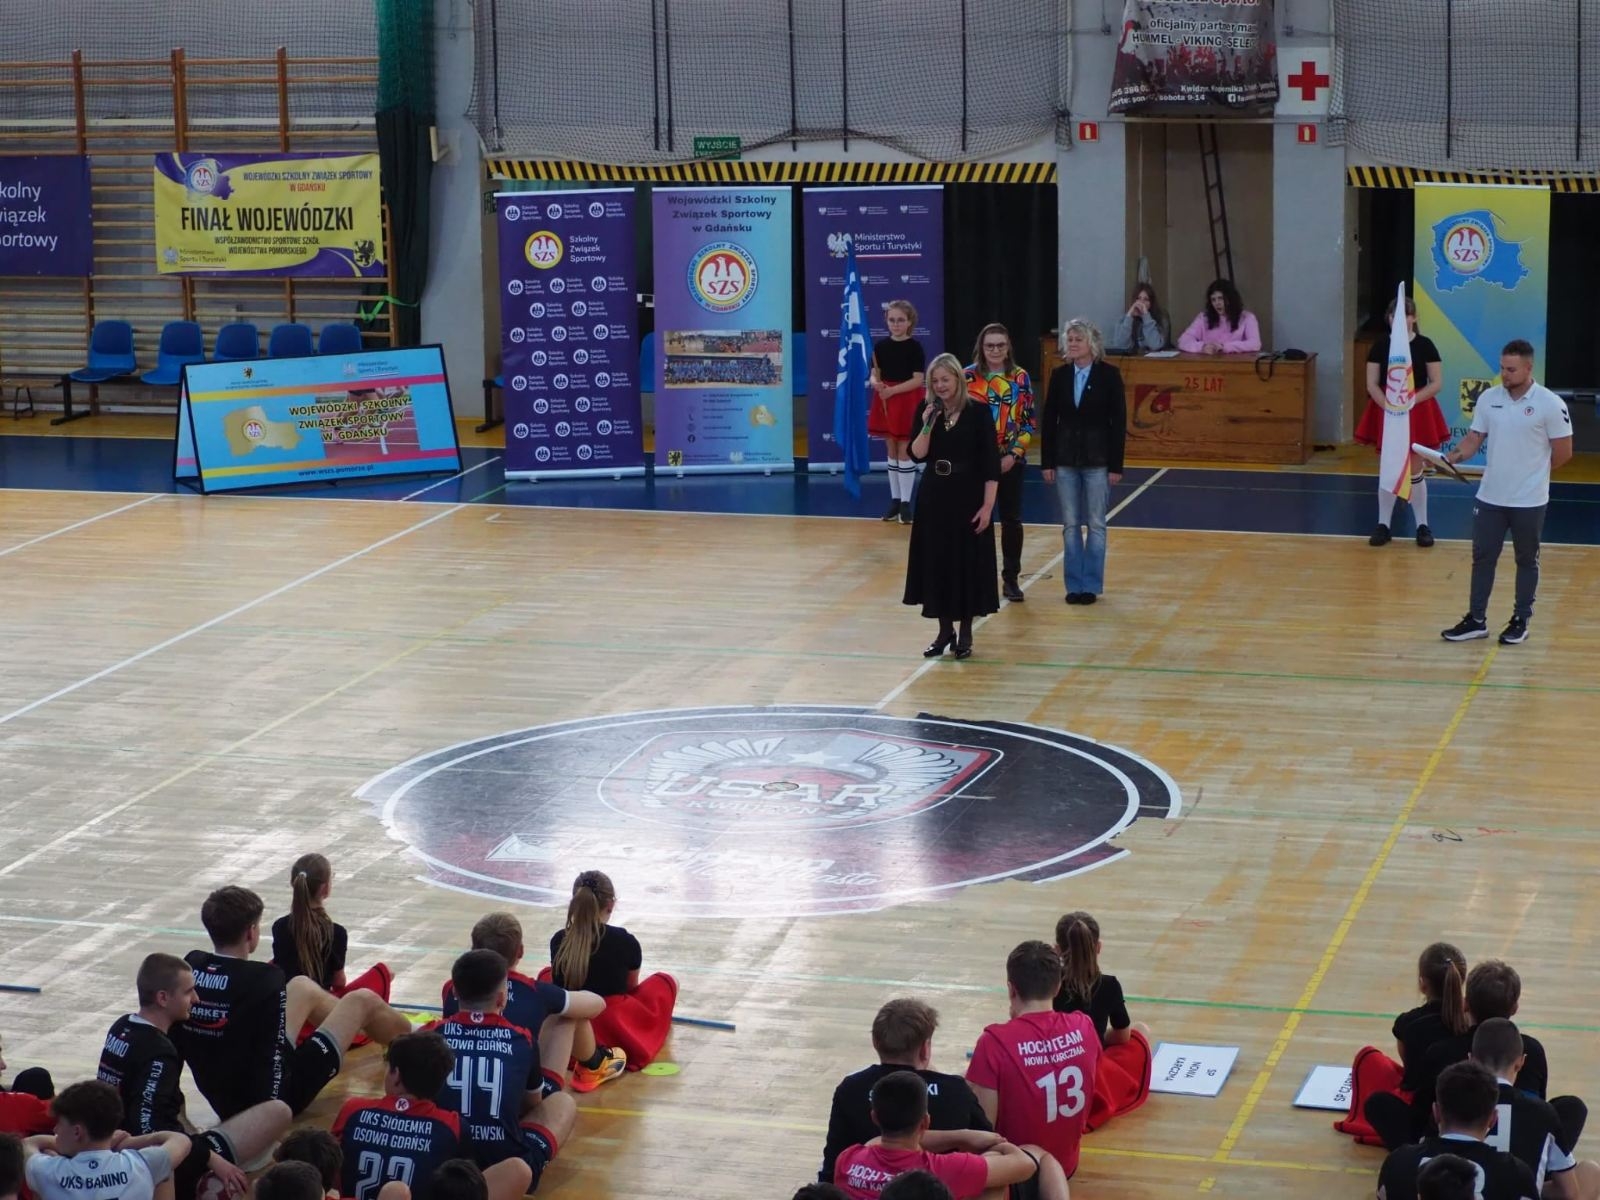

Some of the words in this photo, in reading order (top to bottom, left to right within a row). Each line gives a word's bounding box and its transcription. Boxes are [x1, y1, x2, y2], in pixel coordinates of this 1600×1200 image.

[1150, 19, 1197, 31] oficjalny
[1200, 21, 1235, 32] partner
[1237, 24, 1257, 32] ma
[1183, 36, 1222, 47] VIKING
[1227, 38, 1257, 48] SELE
[338, 170, 373, 180] SPORTOWY
[667, 195, 732, 206] Wojewódzki
[735, 195, 777, 206] Szkolny
[181, 207, 233, 231] FINAŁ
[236, 202, 354, 231] WOJEWÓDZKI
[672, 209, 717, 220] Związek
[721, 209, 772, 220] Sportowy
[705, 223, 752, 233] Gdańsku
[0, 232, 58, 251] ortowy
[569, 235, 598, 243] Szkolny
[855, 233, 906, 241] Ministerstwo
[570, 245, 600, 254] Związek
[855, 242, 881, 252] Sportu
[887, 241, 922, 252] Turystyki
[534, 251, 555, 262] SZS
[570, 254, 606, 263] Sportowy
[1453, 248, 1480, 262] SZS
[707, 280, 740, 296] SZS
[1184, 377, 1200, 390] 25
[1203, 378, 1224, 393] LAT
[289, 401, 358, 416] WOJEWÓDZKI
[362, 397, 408, 410] SZKOLNY
[298, 418, 344, 430] ZWIĄZEK
[348, 412, 404, 425] SPORTOWY
[322, 432, 333, 441] W
[444, 1022, 463, 1036] UKS
[476, 1038, 514, 1056] GDAŃSK
[1017, 1040, 1053, 1056] HOCH
[1051, 1029, 1084, 1051] TEAM
[1024, 1054, 1050, 1067] NOWA
[1050, 1045, 1086, 1064] KARCZMA
[446, 1055, 504, 1120] 44
[1036, 1065, 1086, 1124] 13
[360, 1110, 380, 1126] UKS
[380, 1114, 434, 1136] SIÓDEMKA
[353, 1127, 389, 1147] OSOWA
[390, 1134, 433, 1153] GDAŃSK
[846, 1163, 882, 1181] HOCH
[60, 1175, 83, 1190] UKS
[86, 1171, 129, 1190] BANINO
